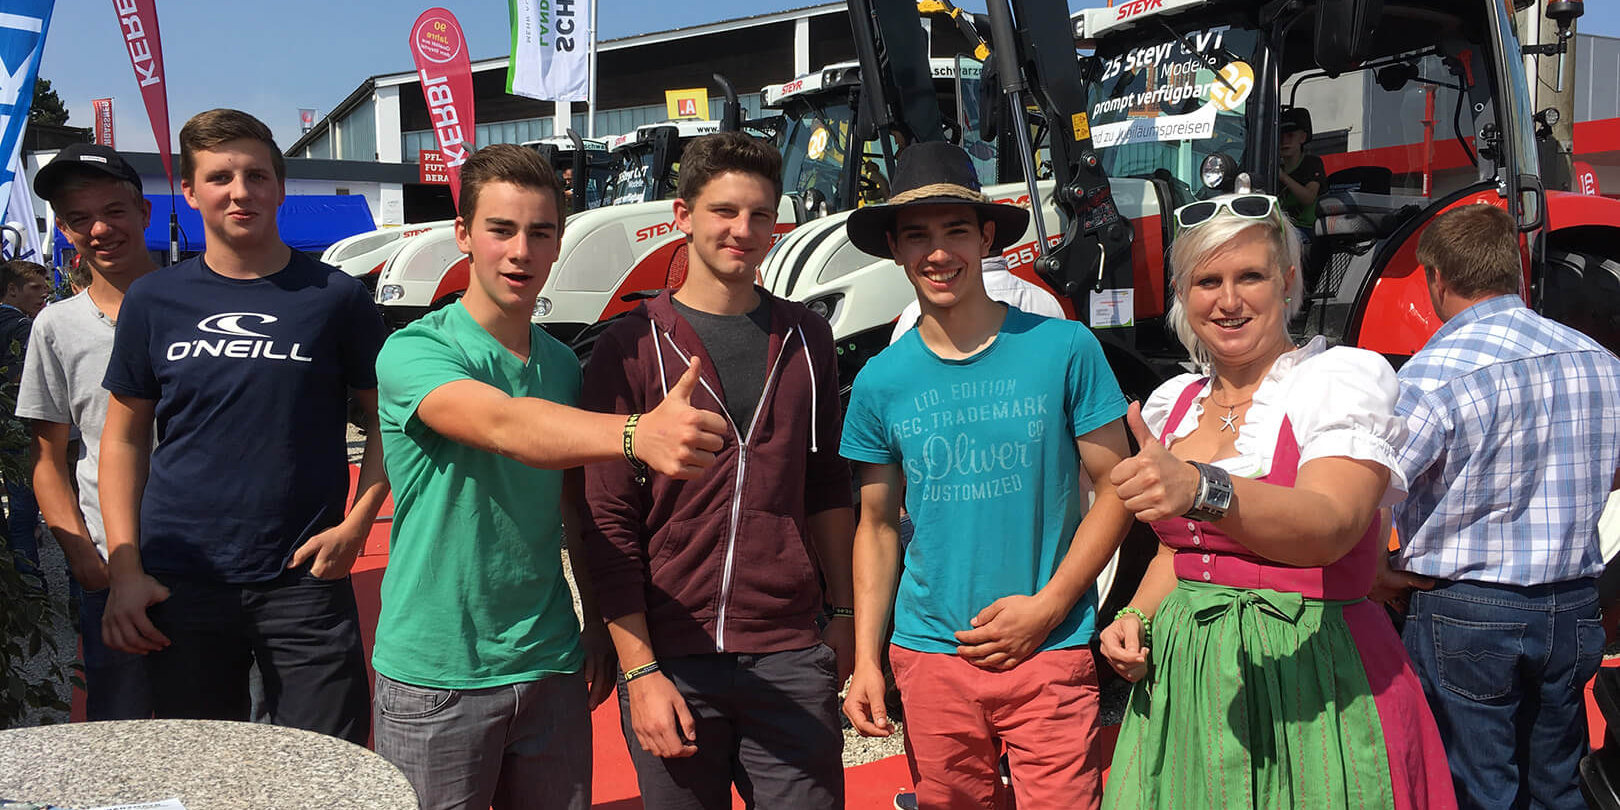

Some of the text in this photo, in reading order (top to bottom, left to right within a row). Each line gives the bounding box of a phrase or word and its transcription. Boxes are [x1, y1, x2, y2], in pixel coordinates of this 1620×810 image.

[1116, 0, 1163, 21] STEYR
[1101, 53, 1124, 82] 25
[1124, 40, 1177, 72] Steyr
[1091, 81, 1211, 119] prompt verfügbar
[1104, 132, 1115, 143] zu
[425, 164, 447, 172] FUT
[636, 220, 678, 242] STEY
[167, 340, 313, 362] O'NEILL
[914, 378, 1016, 412] LTD. EDITION
[931, 394, 1048, 429] TRADEMARK
[922, 474, 1023, 502] CUSTOMIZED
